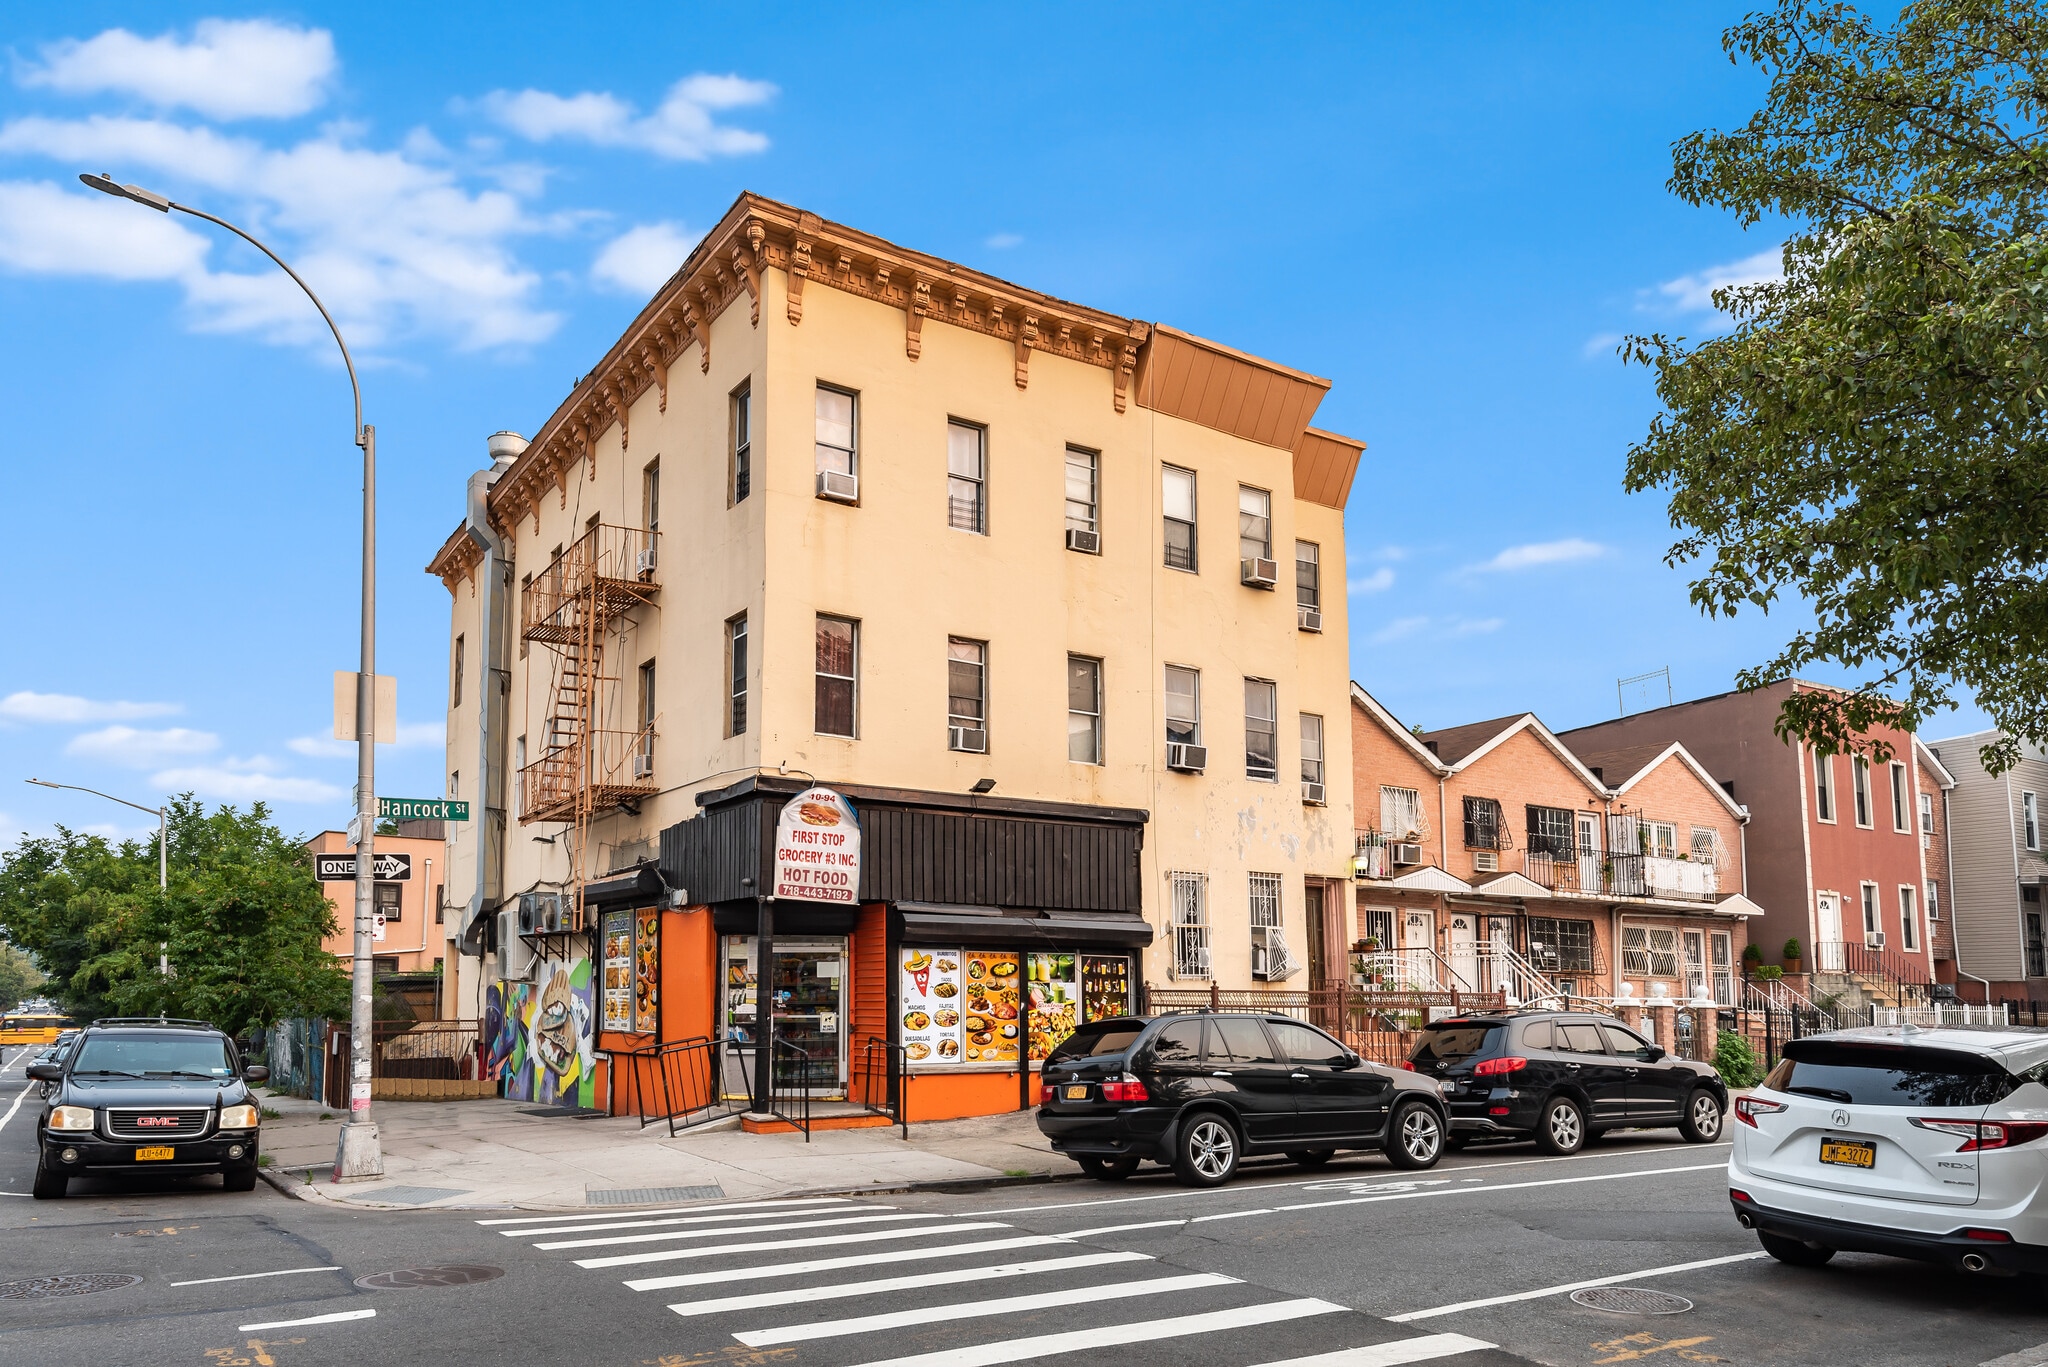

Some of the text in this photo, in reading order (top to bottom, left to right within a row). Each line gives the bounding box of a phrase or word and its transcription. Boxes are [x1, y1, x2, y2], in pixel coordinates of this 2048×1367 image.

[810, 793, 835, 802] 10-94
[381, 800, 466, 818] Hancock St
[792, 830, 845, 846] FIRST STOP
[779, 848, 857, 867] GROCERY #3 INC.
[324, 861, 401, 873] ONE WAY
[783, 867, 848, 886] HOT FOOD
[783, 885, 849, 900] 718-443-7192
[137, 1117, 179, 1127] GMC
[1937, 1161, 1976, 1171] RDX
